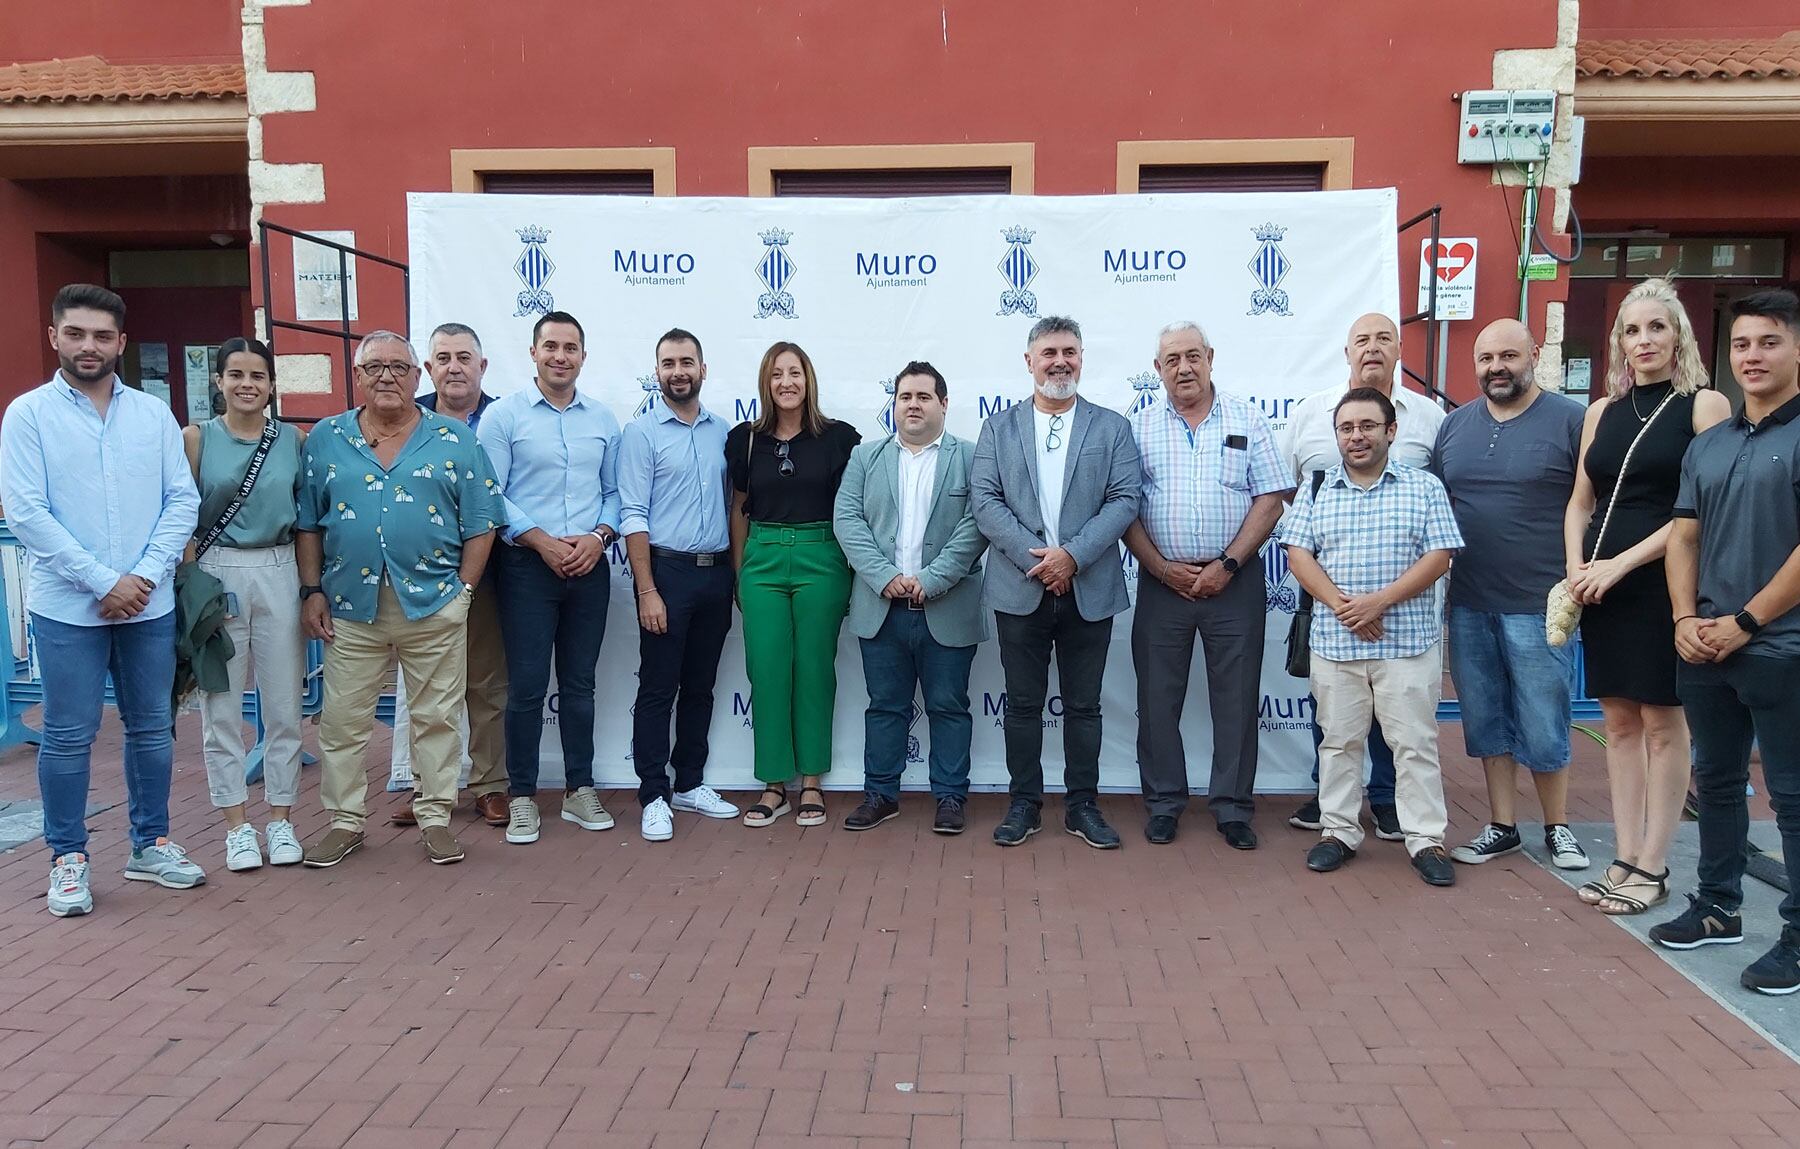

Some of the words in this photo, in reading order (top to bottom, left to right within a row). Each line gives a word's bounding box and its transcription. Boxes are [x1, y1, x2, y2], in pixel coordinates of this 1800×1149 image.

[614, 249, 695, 274] Muro
[856, 252, 937, 276] Muro
[1104, 248, 1187, 273] Muro
[624, 274, 686, 287] Ajuntament
[866, 277, 927, 290] Ajuntament
[1114, 273, 1177, 286] Ajuntament
[1249, 396, 1307, 419] ur
[1259, 720, 1313, 732] Ajuntame
